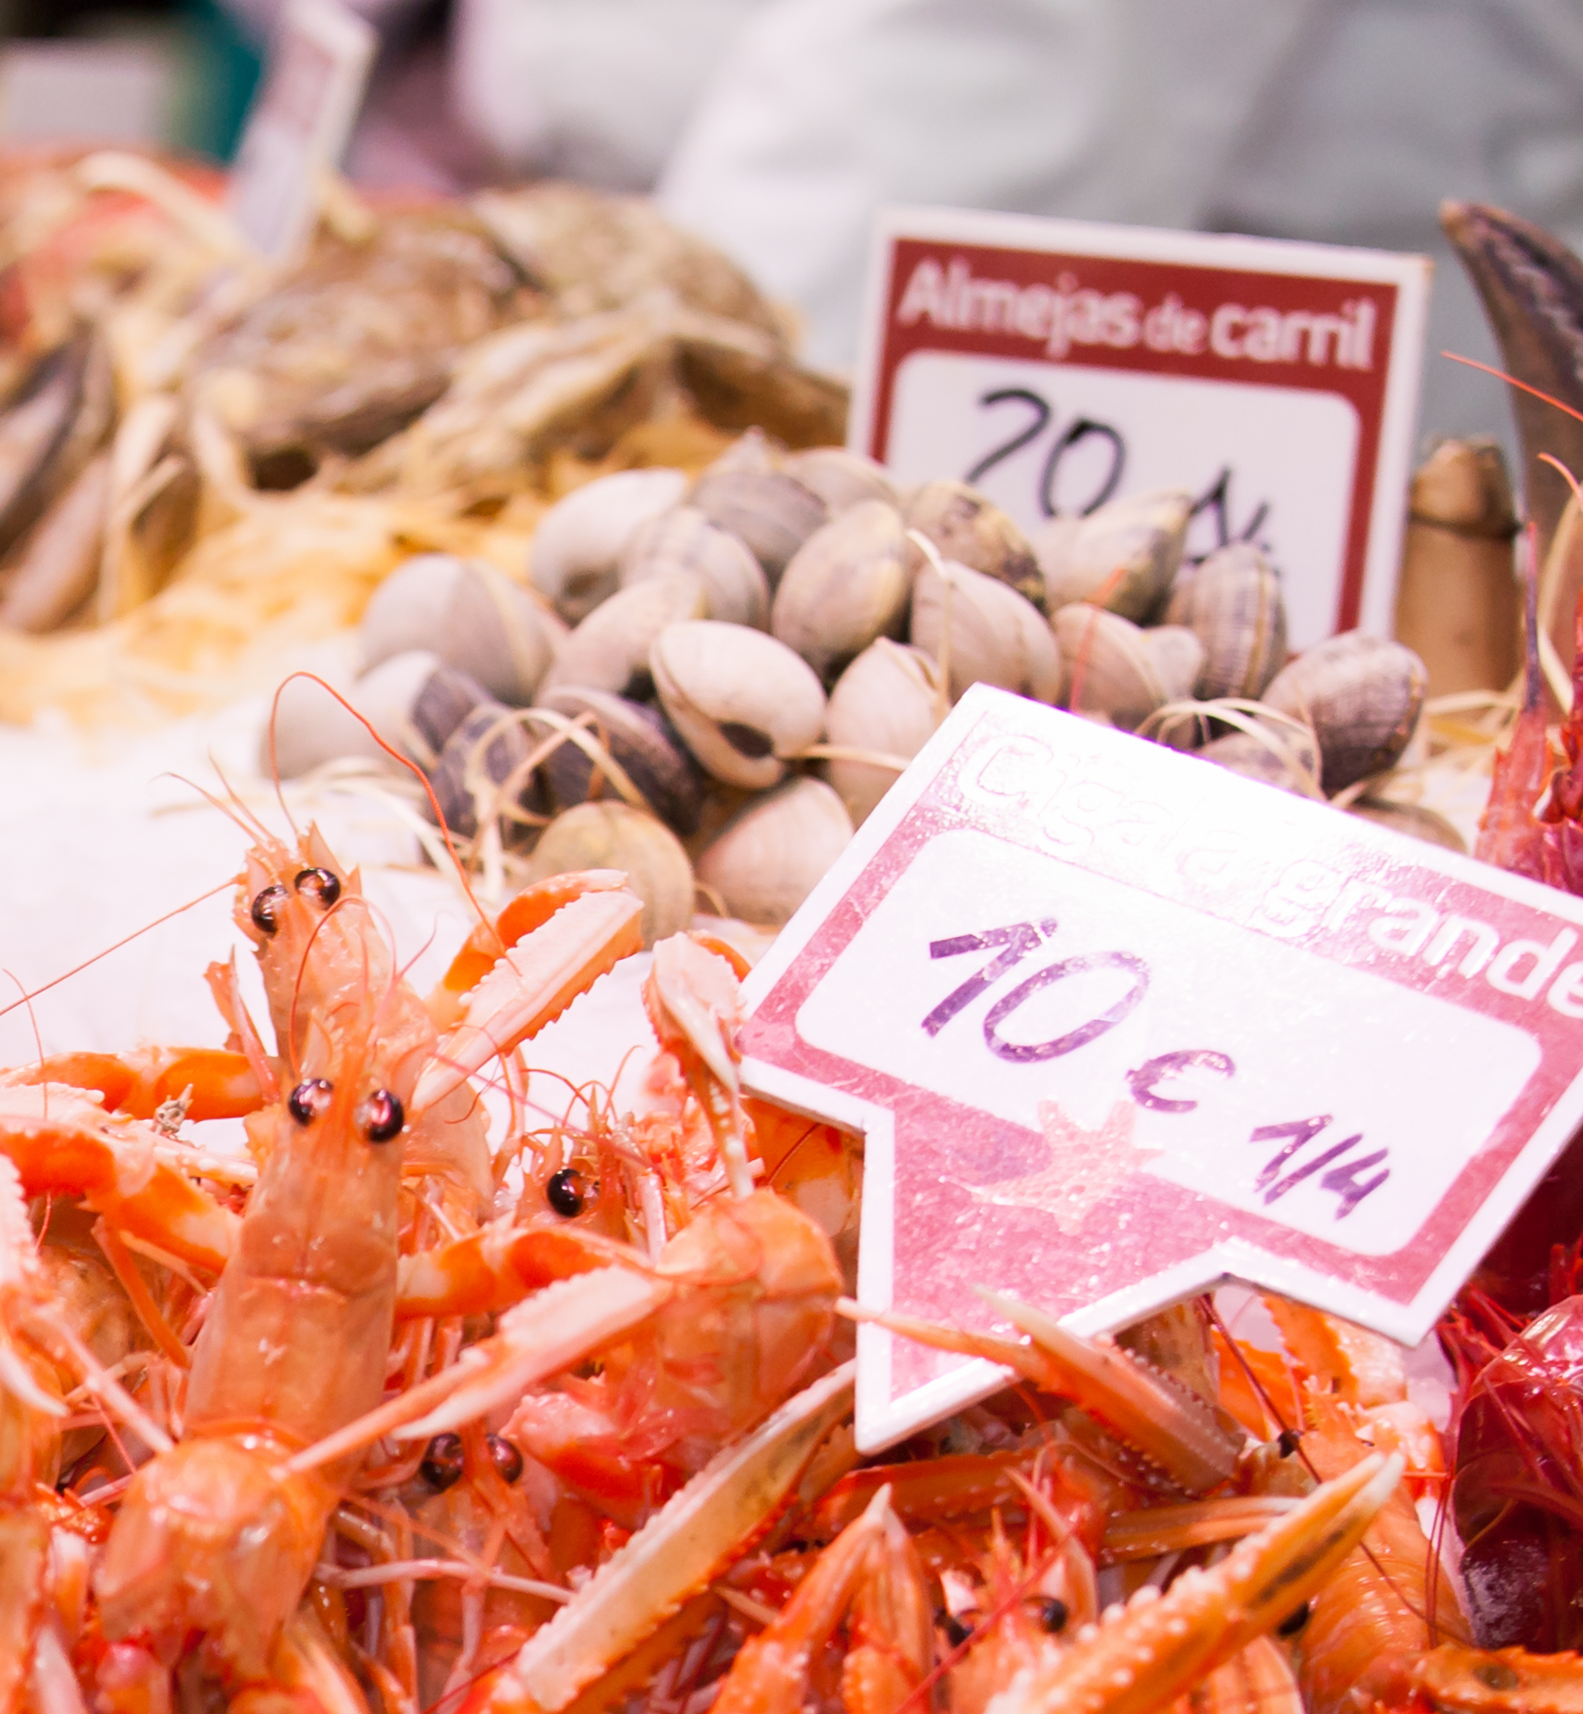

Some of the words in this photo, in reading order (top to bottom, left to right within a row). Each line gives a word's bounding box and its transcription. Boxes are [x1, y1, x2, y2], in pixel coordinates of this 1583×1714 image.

[895, 255, 1141, 360] Almejas
[1143, 291, 1208, 355] de
[1210, 298, 1378, 371] carril
[964, 388, 1127, 518] 20
[920, 917, 1151, 1064] 10
[1125, 1049, 1236, 1114] €
[1249, 1113, 1391, 1221] 1/4
